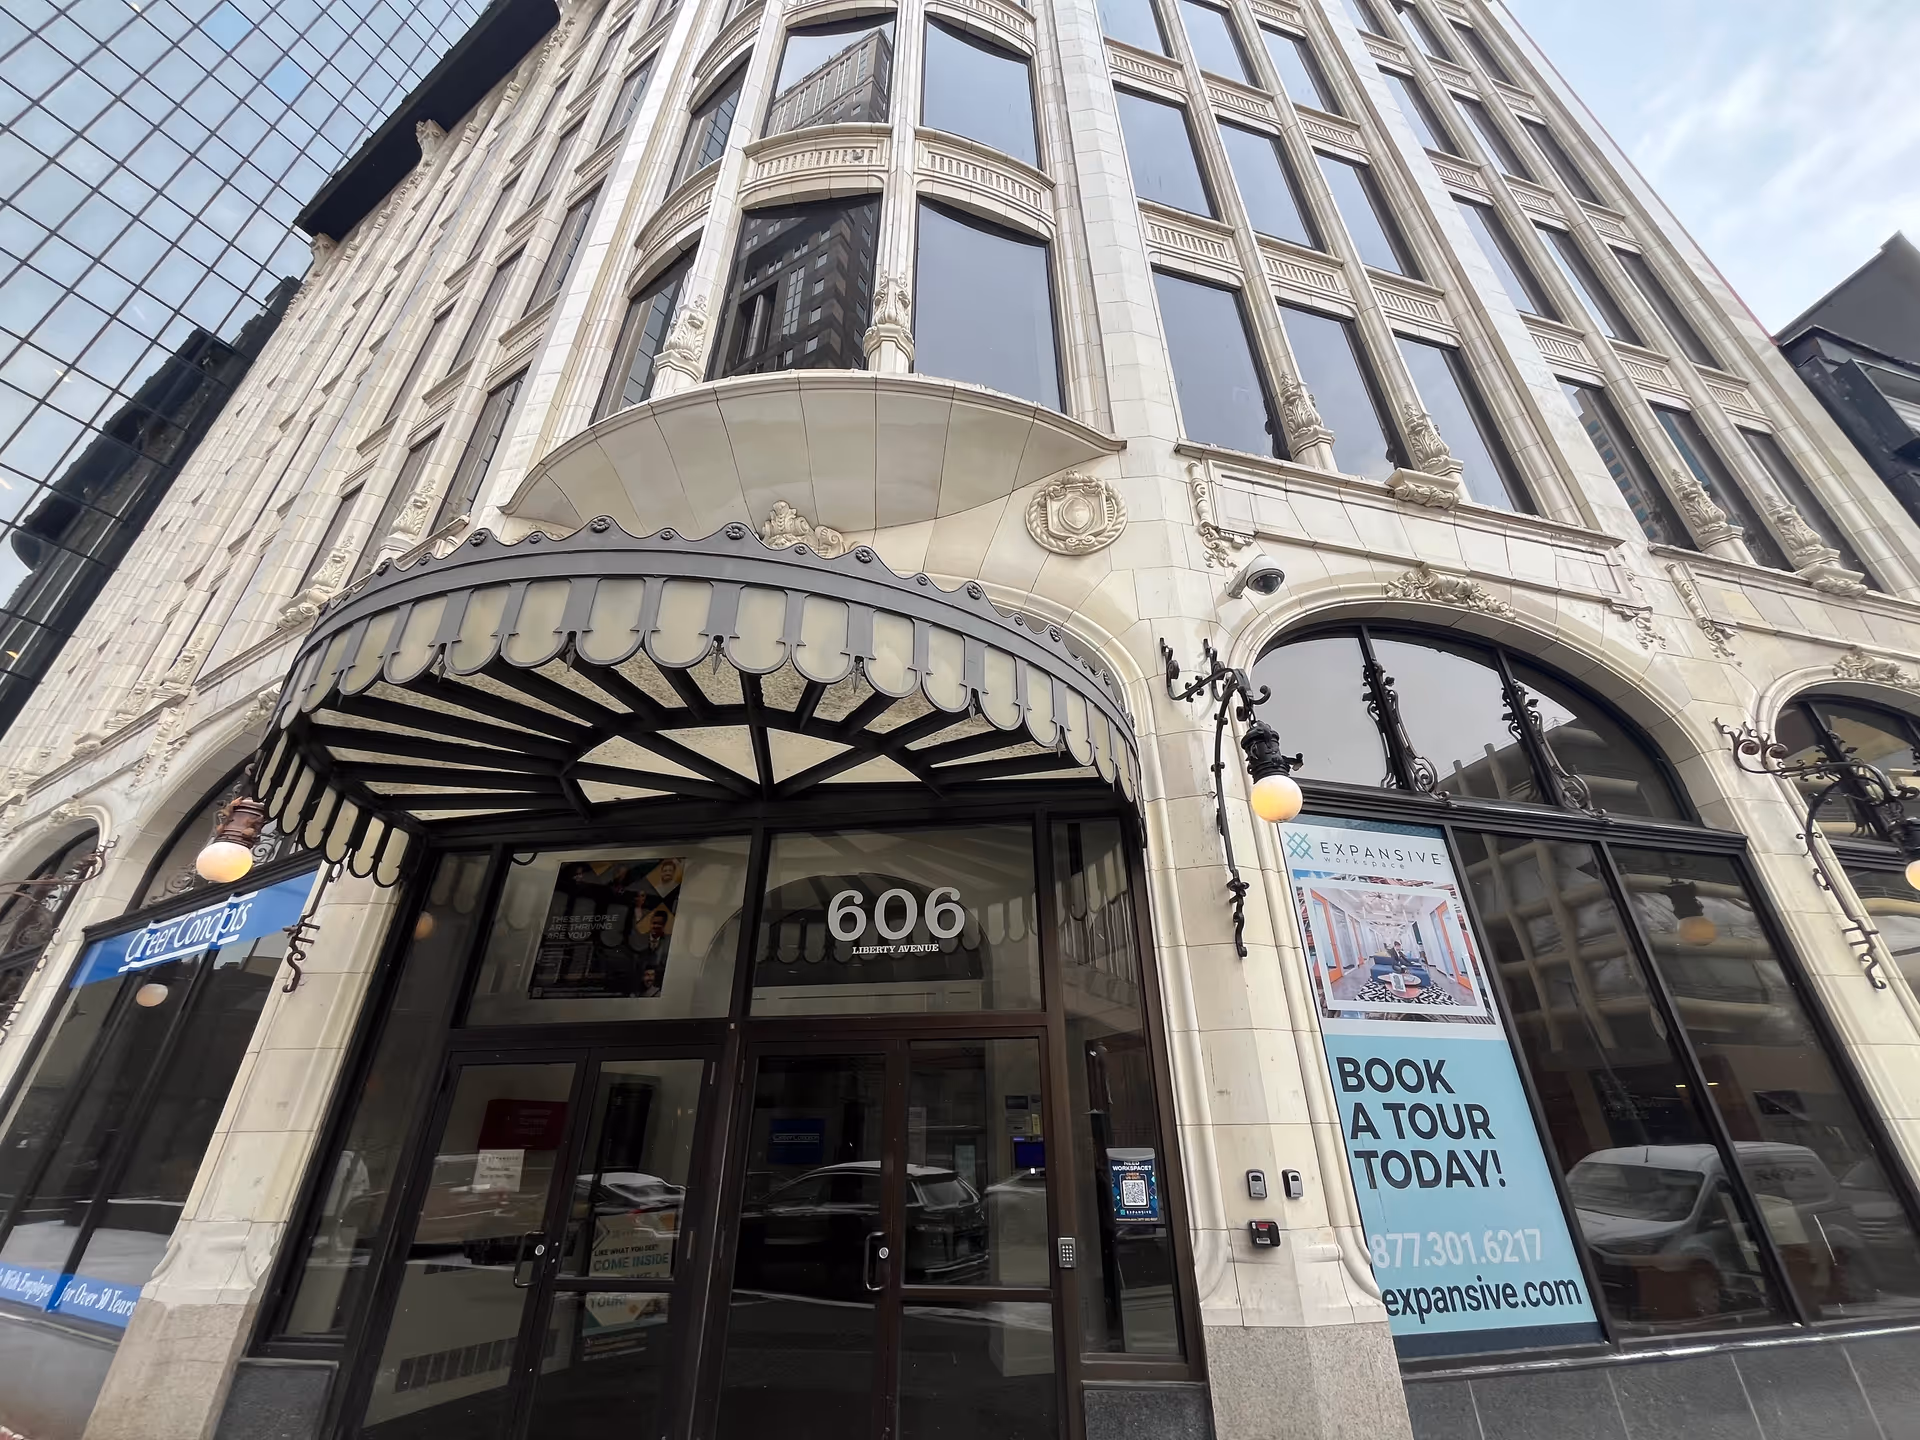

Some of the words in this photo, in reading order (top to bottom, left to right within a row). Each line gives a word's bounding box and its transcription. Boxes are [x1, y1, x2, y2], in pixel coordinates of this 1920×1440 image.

[1320, 842, 1442, 866] EXPANSIVE
[1323, 857, 1405, 870] workspace
[552, 915, 581, 923] THESE
[582, 914, 619, 922] PEOPLE
[828, 887, 965, 942] 606
[852, 945, 896, 955] LIBERTY
[897, 943, 939, 953] AVENUE
[1336, 1056, 1456, 1094] BOOK
[1350, 1102, 1382, 1140] A
[1382, 1102, 1496, 1140] TOUR
[1354, 1149, 1506, 1190] TODAY!
[594, 1249, 609, 1257] LIKE
[610, 1247, 630, 1255] WHAT
[594, 1257, 630, 1272] COME
[632, 1252, 669, 1268] INSIDE
[1371, 1229, 1542, 1269] 877.301.6217
[107, 1290, 138, 1316] Years
[1381, 1275, 1583, 1325] expansive.com
